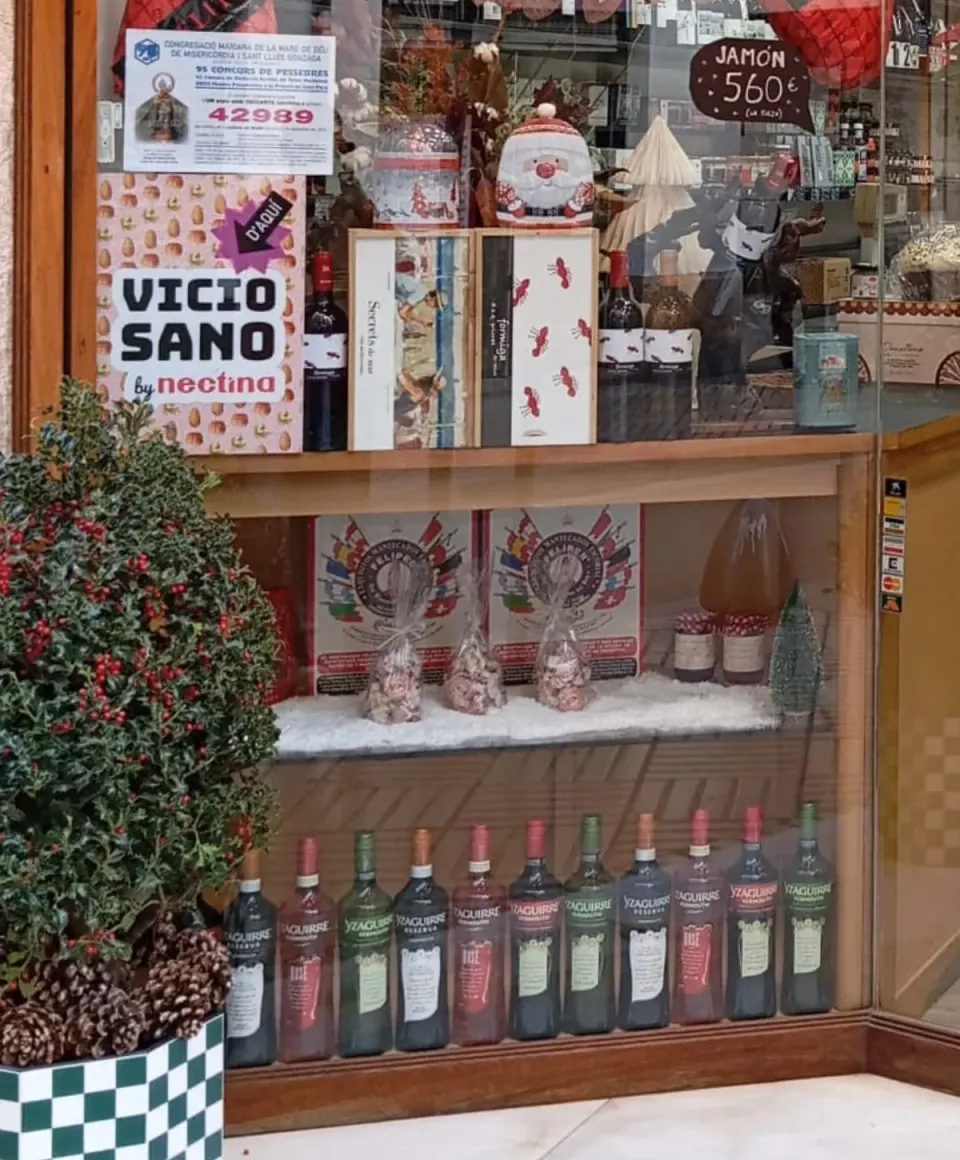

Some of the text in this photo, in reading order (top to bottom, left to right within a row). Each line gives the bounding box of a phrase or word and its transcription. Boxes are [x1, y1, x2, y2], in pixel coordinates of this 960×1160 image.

[715, 45, 785, 68] JAMÓN
[212, 66, 256, 75] CONCURS
[259, 68, 273, 76] DE
[208, 107, 314, 124] 42989
[244, 199, 283, 242] D'AQUÍ
[123, 278, 276, 312] VICIO
[121, 322, 275, 361] SANO
[134, 372, 275, 400] by nectina
[565, 898, 612, 912] ZAGUIRRE
[675, 889, 720, 902] ZAGUIRRE
[454, 906, 501, 919] ZAGUIRRE
